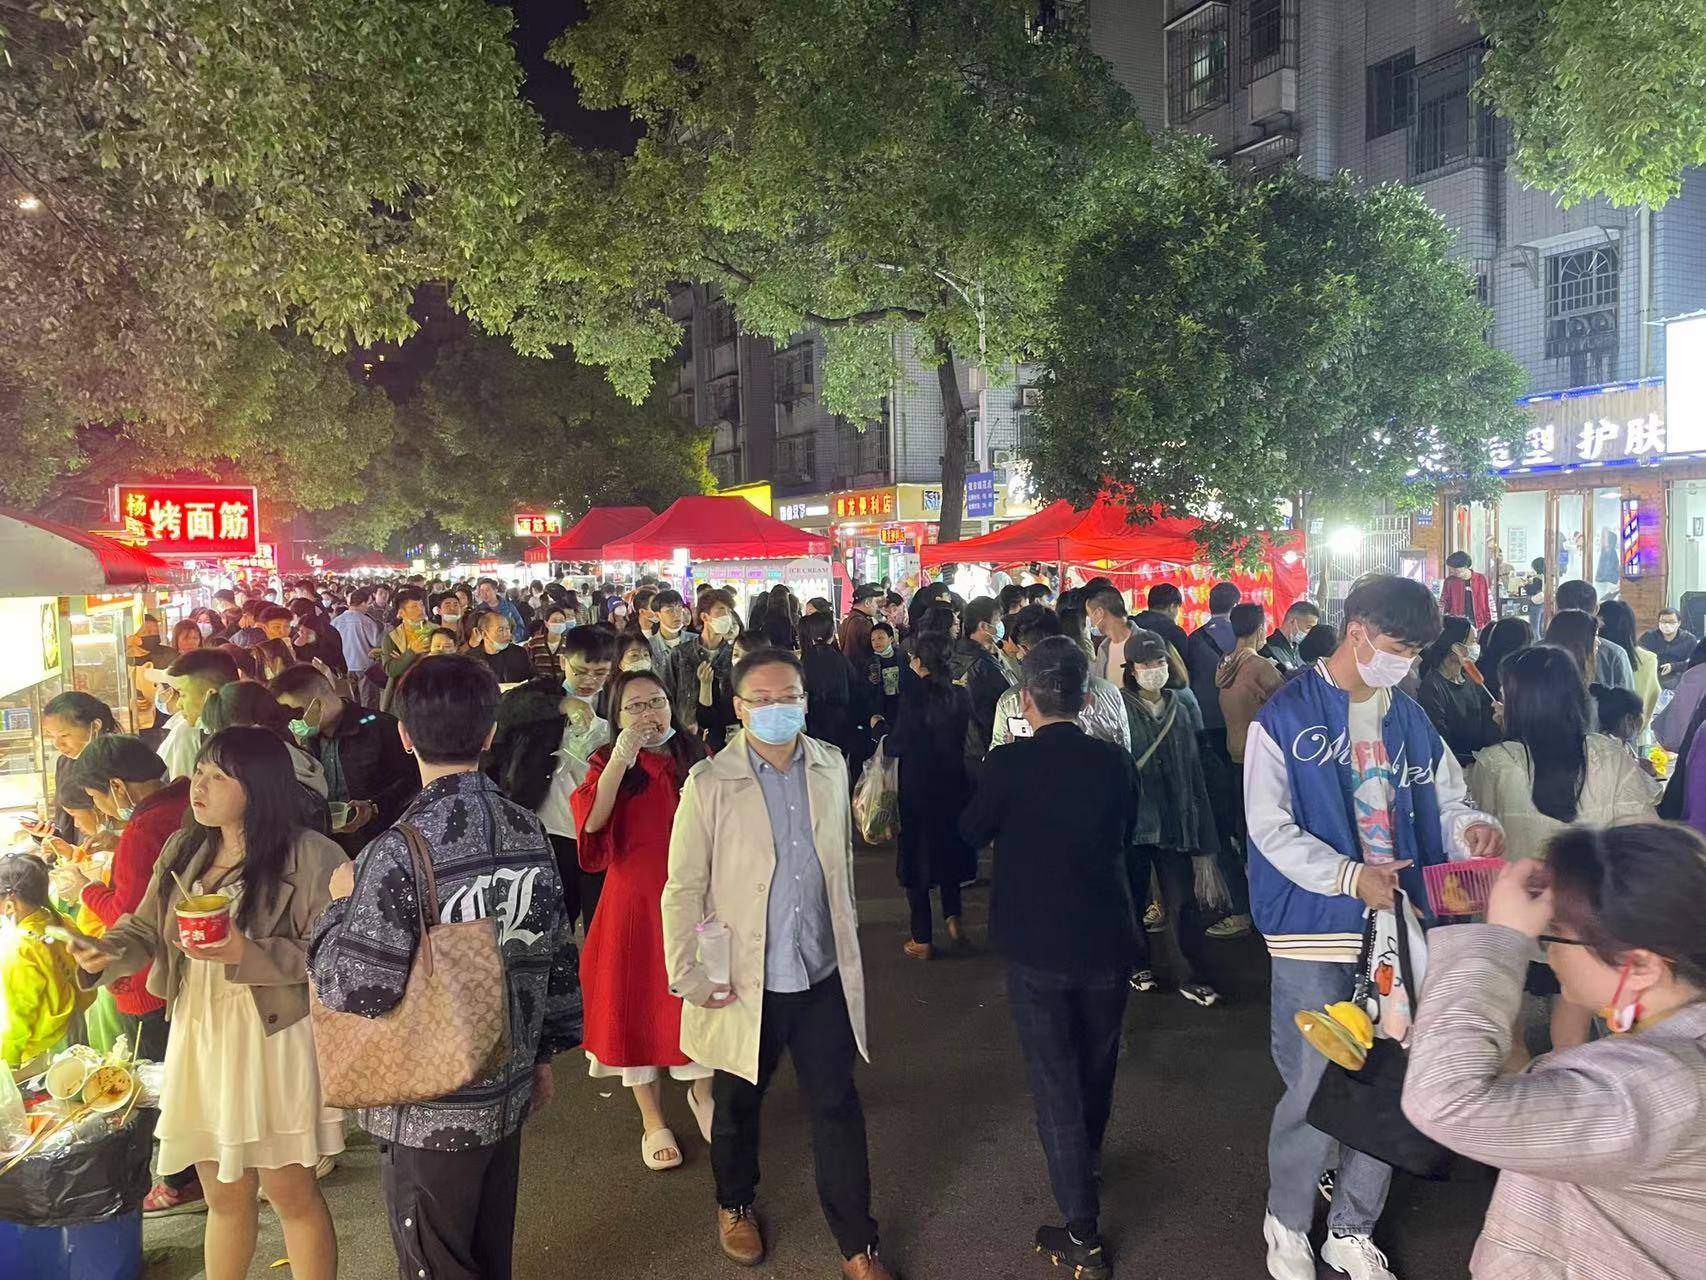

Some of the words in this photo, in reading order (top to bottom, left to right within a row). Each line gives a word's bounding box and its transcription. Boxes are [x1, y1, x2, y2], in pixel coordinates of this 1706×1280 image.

[1576, 411, 1667, 460] 护肤
[150, 500, 248, 540] 烤面筋
